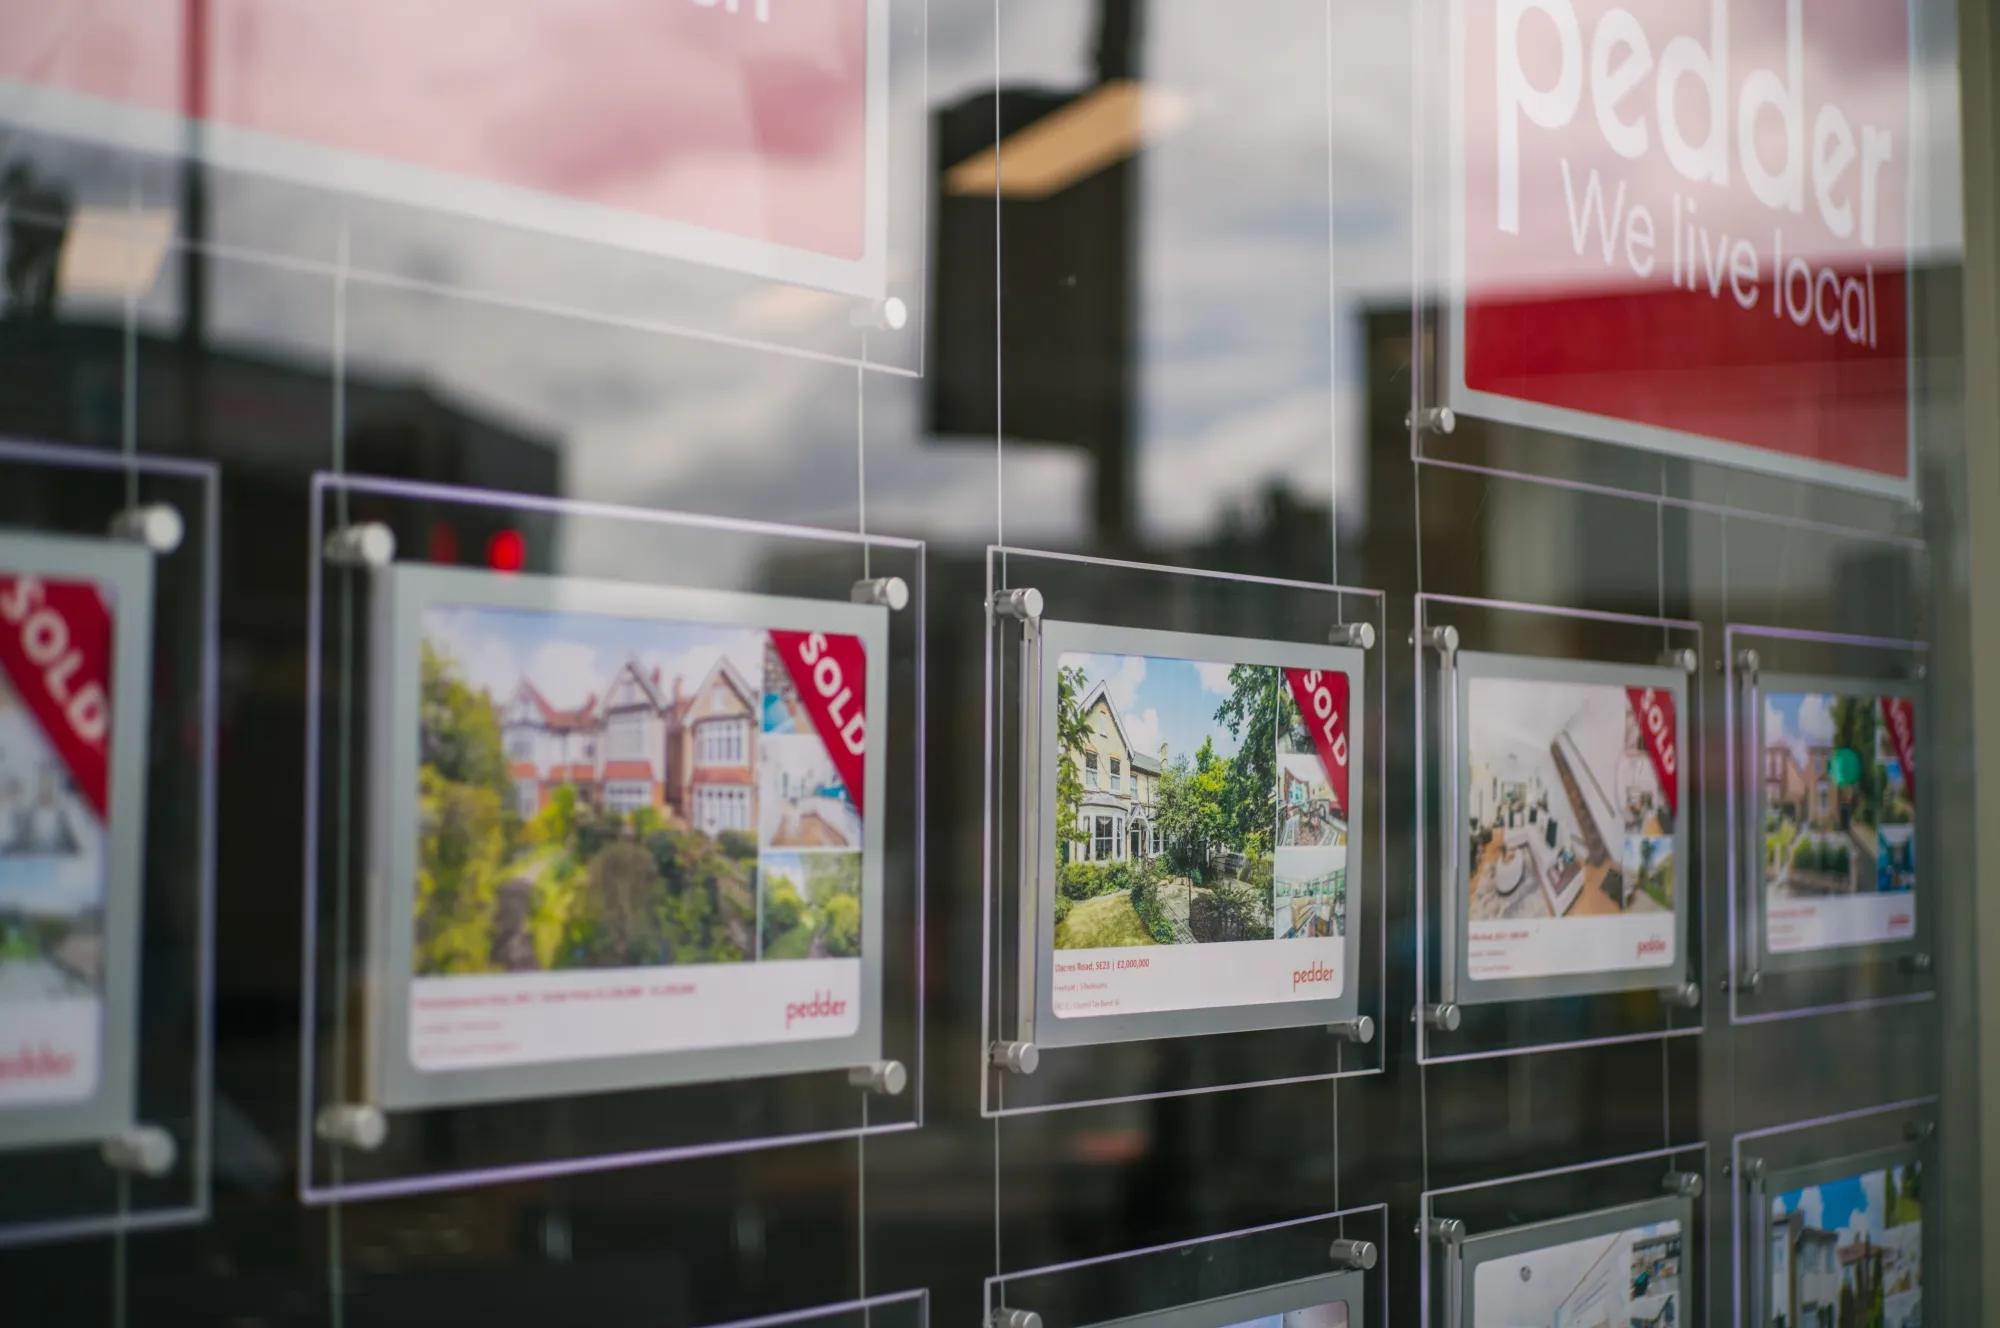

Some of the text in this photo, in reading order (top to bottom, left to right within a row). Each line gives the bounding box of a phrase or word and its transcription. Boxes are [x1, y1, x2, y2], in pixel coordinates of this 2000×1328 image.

[1497, 0, 1892, 248] pedder
[1560, 158, 1877, 349] We live local
[0, 572, 108, 742] SOLD
[798, 632, 866, 756] SOLD
[1303, 669, 1348, 767] SOLD
[1640, 687, 1676, 775] SOLD
[785, 988, 847, 1030] pedder
[1095, 960, 1111, 970] SE23
[1292, 960, 1335, 993] pedder
